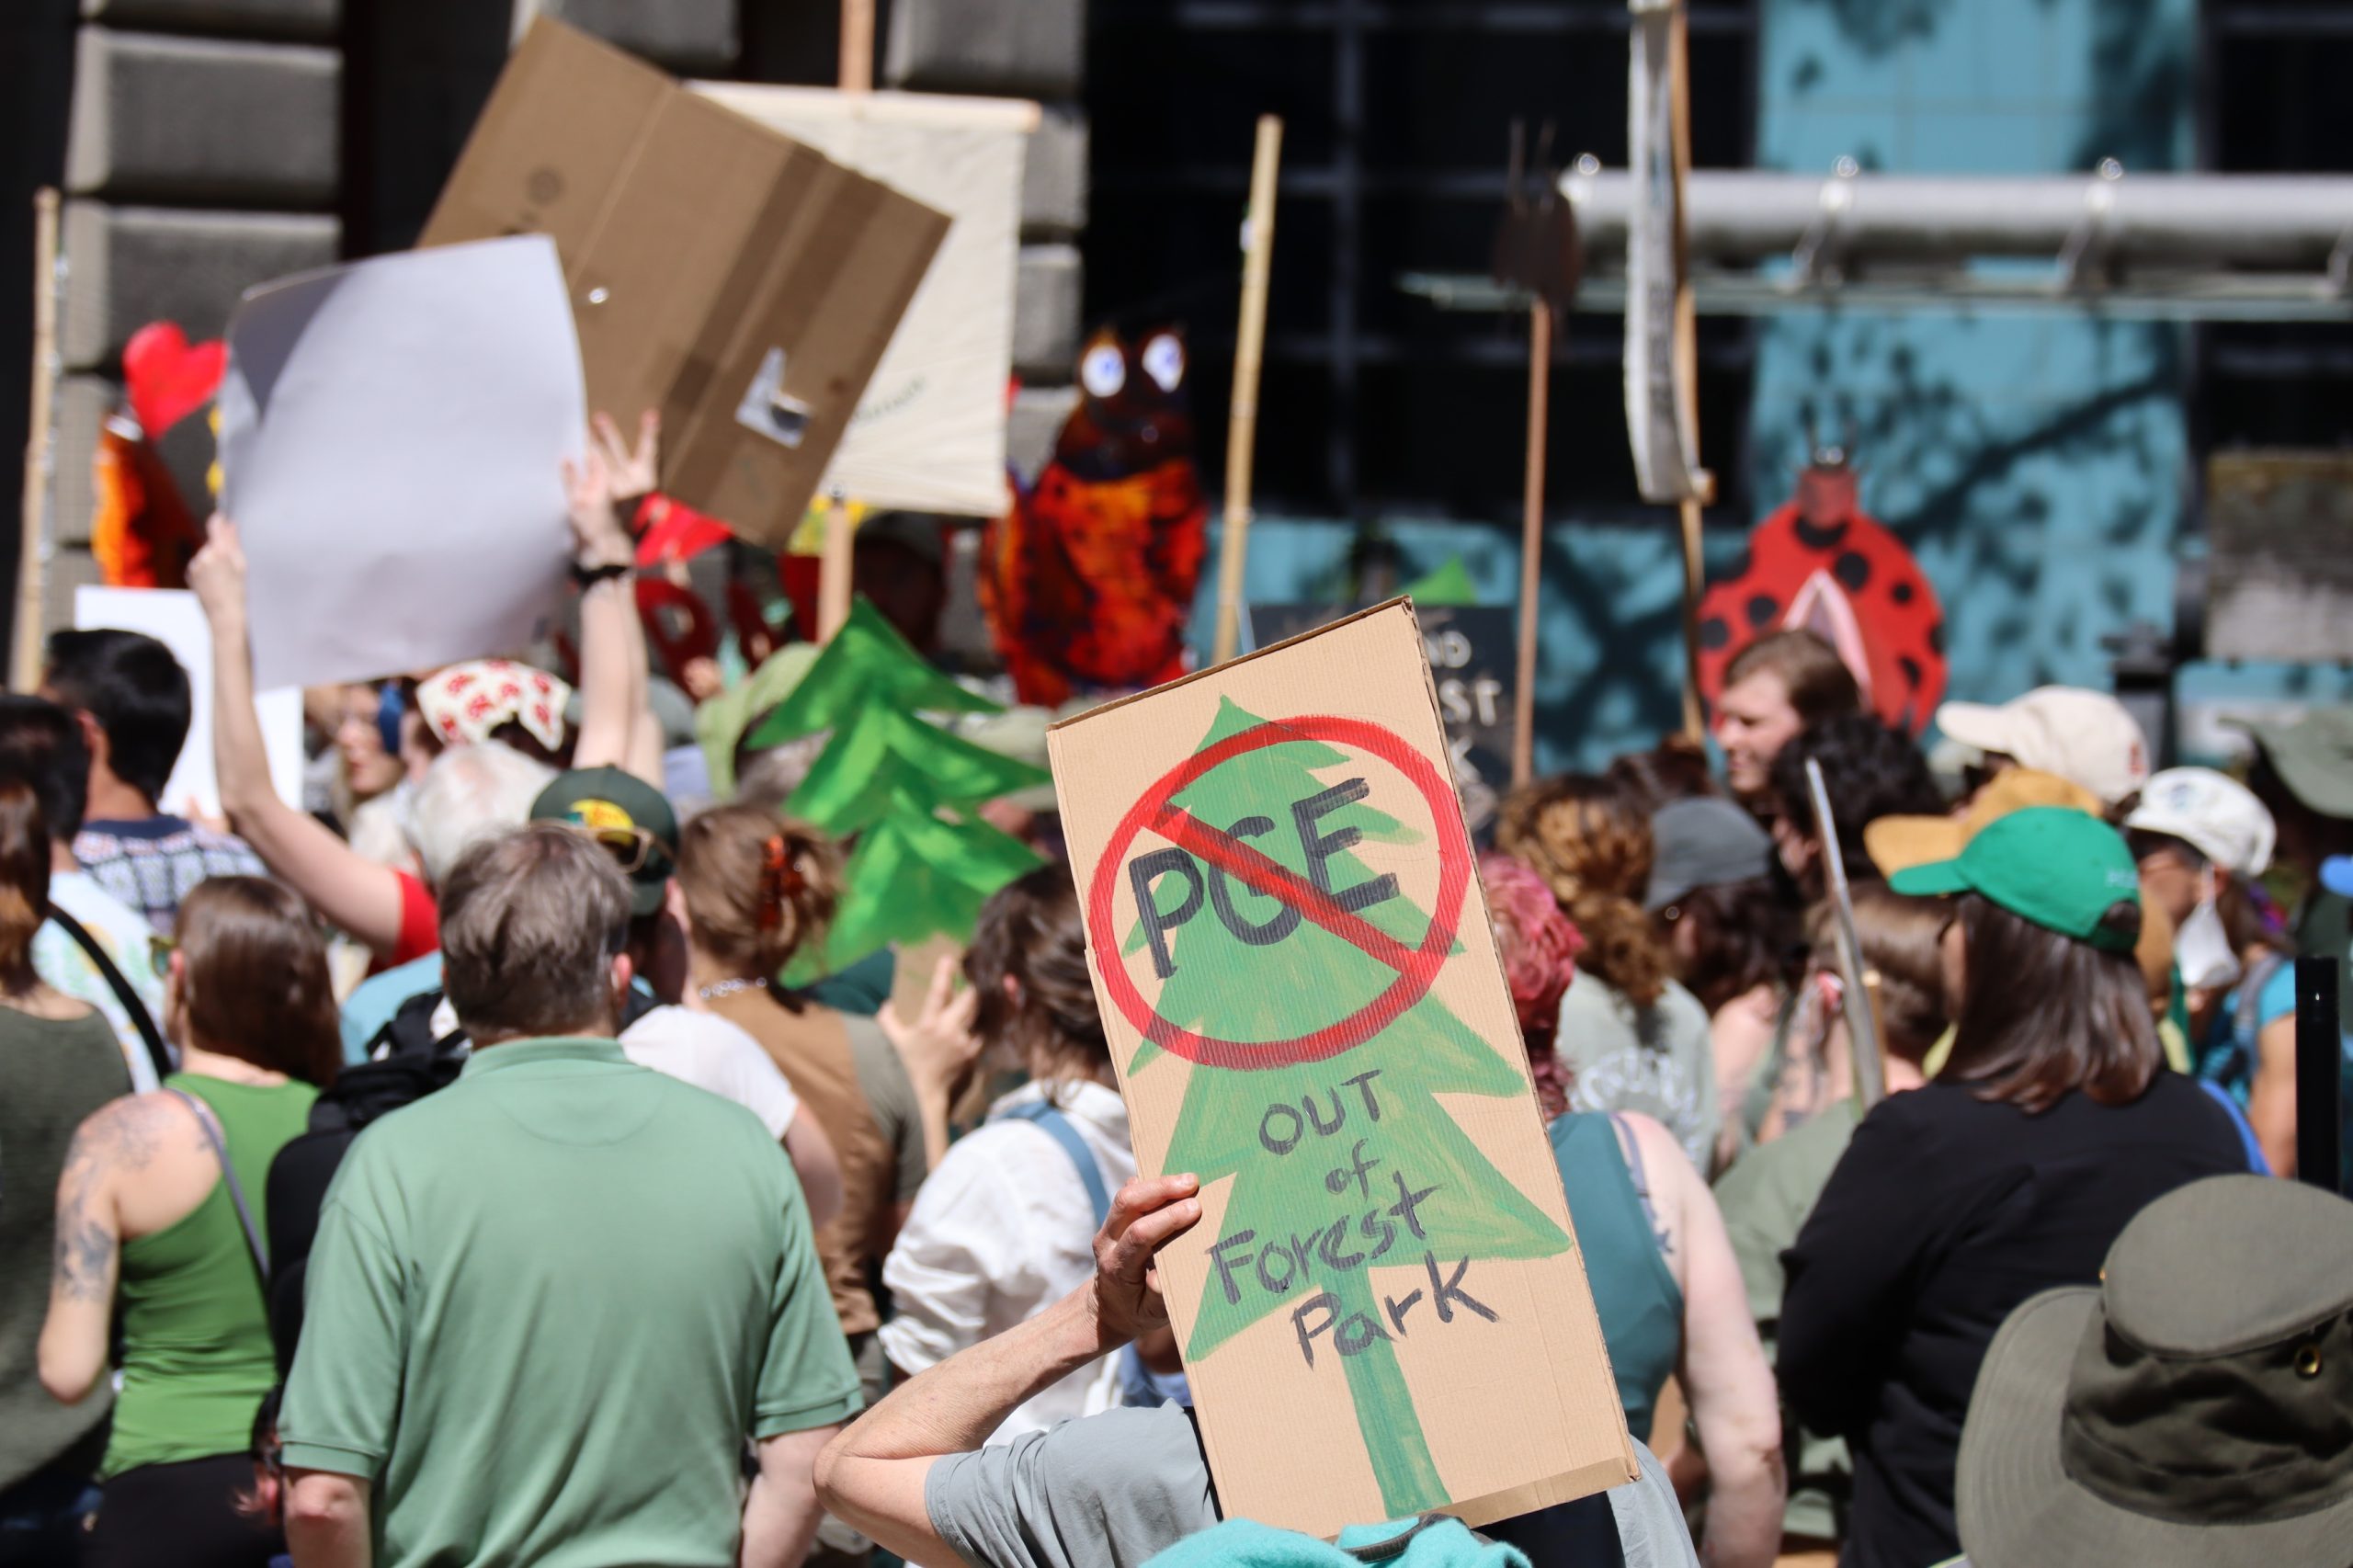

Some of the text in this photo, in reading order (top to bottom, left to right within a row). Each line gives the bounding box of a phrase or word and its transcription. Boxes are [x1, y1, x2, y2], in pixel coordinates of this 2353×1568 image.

[1130, 778, 1400, 981] PGE
[1258, 1069, 1382, 1155] OUT
[1324, 1138, 1381, 1200] of
[1205, 1170, 1443, 1305] Forest
